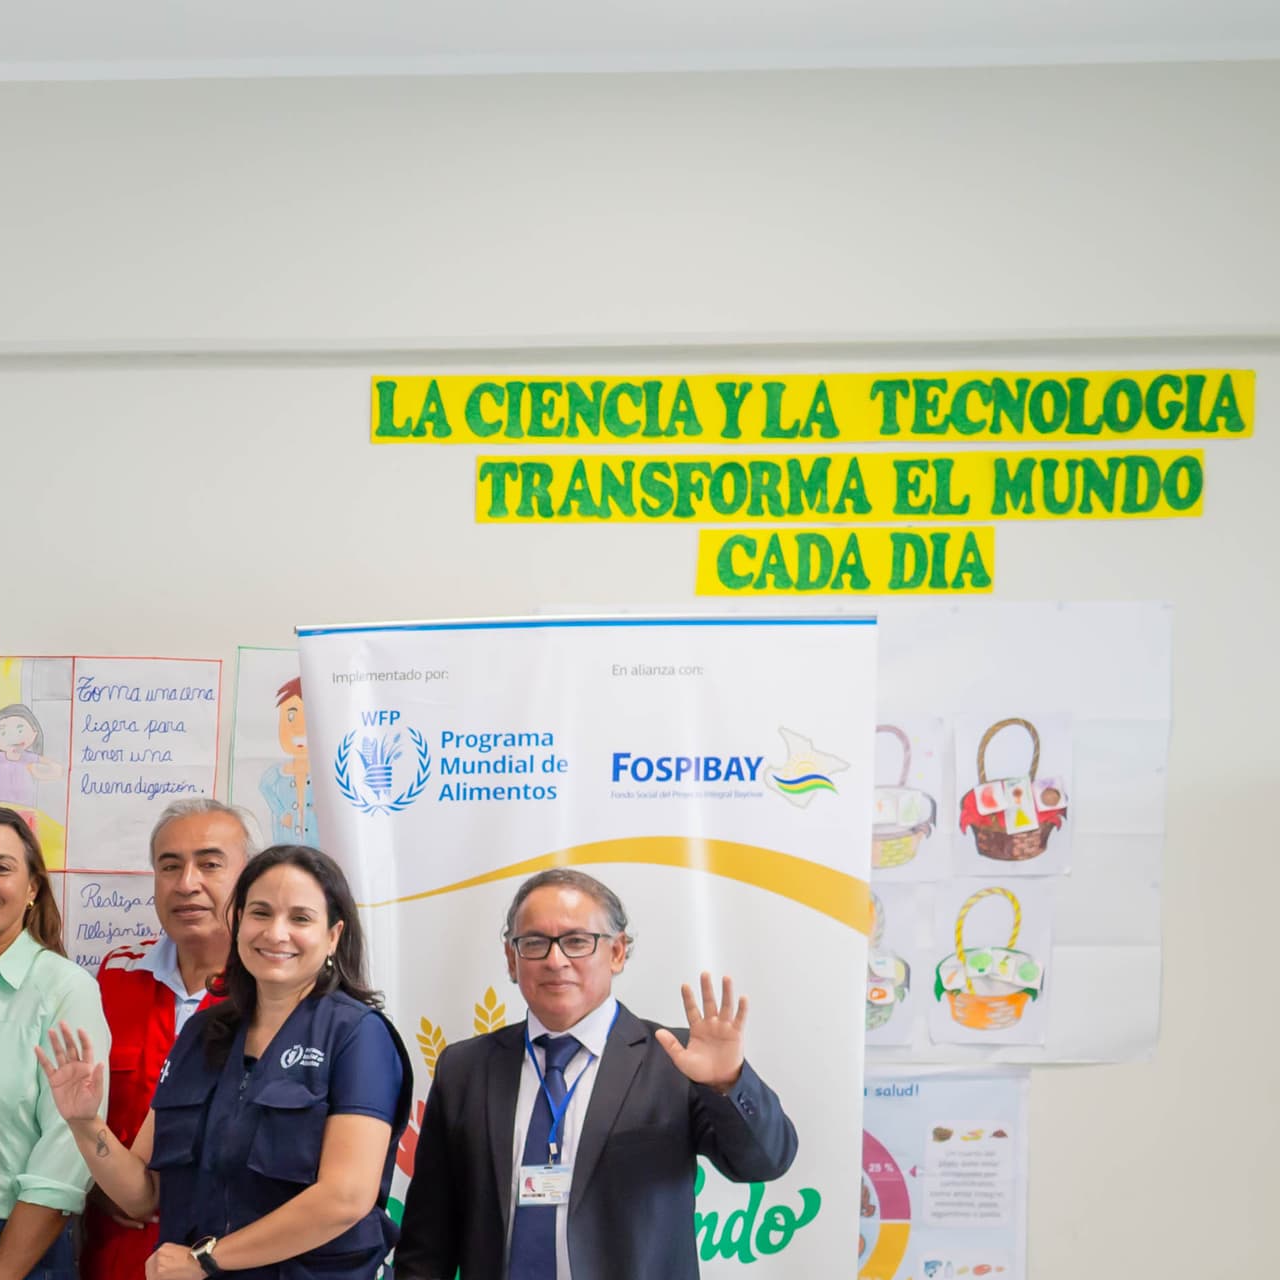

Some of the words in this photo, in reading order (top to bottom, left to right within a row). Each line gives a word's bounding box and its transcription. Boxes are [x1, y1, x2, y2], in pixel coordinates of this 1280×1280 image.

[376, 379, 452, 438] LA
[464, 380, 703, 438] CIENCIA
[716, 382, 753, 439] Y
[761, 381, 840, 439] LA
[870, 374, 1245, 436] TECNOLOGIA
[479, 457, 872, 518] TRANSFORMA
[893, 458, 970, 515] EL
[991, 455, 1204, 515] MUNDO
[717, 533, 871, 591] CADA
[888, 532, 991, 590] DIA
[332, 668, 422, 686] Implementado
[425, 670, 449, 683] por:
[612, 664, 627, 676] En
[631, 664, 675, 676] alianza
[82, 714, 139, 742] ligera
[144, 720, 186, 740] para
[361, 710, 401, 726] WFP
[441, 730, 554, 753] Programa
[81, 746, 123, 763] tener
[129, 749, 173, 762] una
[440, 755, 534, 775] Mundial
[541, 754, 568, 773] de
[612, 752, 764, 782] FOSPIBAY
[438, 782, 558, 801] Alimentos
[81, 883, 142, 913] Realiza
[875, 1083, 919, 1097] salud!
